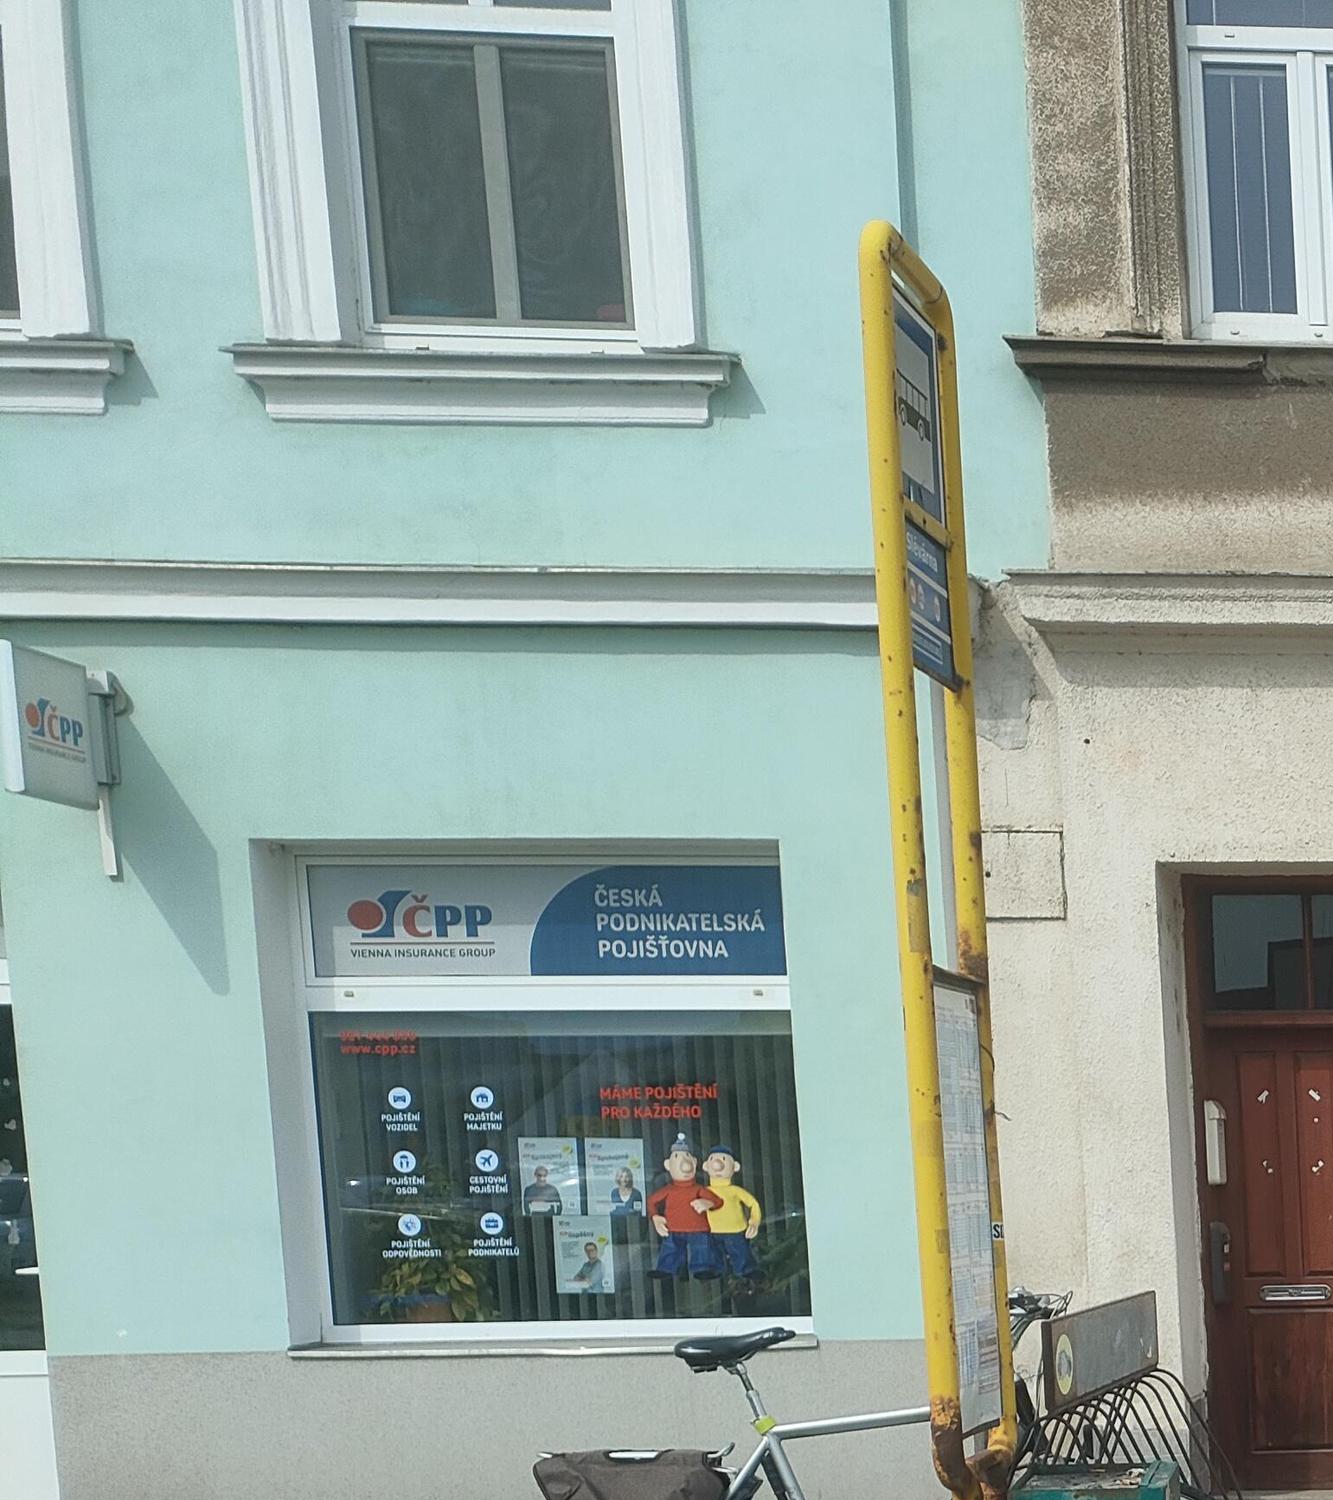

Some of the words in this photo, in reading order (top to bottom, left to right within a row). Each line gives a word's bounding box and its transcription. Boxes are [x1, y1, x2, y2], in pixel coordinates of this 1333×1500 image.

[47, 704, 84, 746] ČPP
[594, 884, 663, 907] ČESKÁ
[403, 894, 492, 938] ČPP
[596, 909, 765, 932] PODNIKATELSKÁ
[351, 949, 391, 958] VIENNA
[395, 948, 455, 958] INSURANCE
[459, 948, 496, 957] GROUP
[598, 935, 729, 958] POJIŠŤOVNA
[600, 1085, 640, 1099] MÁME
[645, 1083, 719, 1099] POJIŠTĚNÍ
[381, 1112, 420, 1121] POJIŠTĚNÍ
[464, 1111, 502, 1121] POJIŠTĚNÍ
[601, 1106, 630, 1119] PRO
[634, 1103, 702, 1119] KAŽDÉHO
[386, 1175, 425, 1185] POJIŠTĚNÍ
